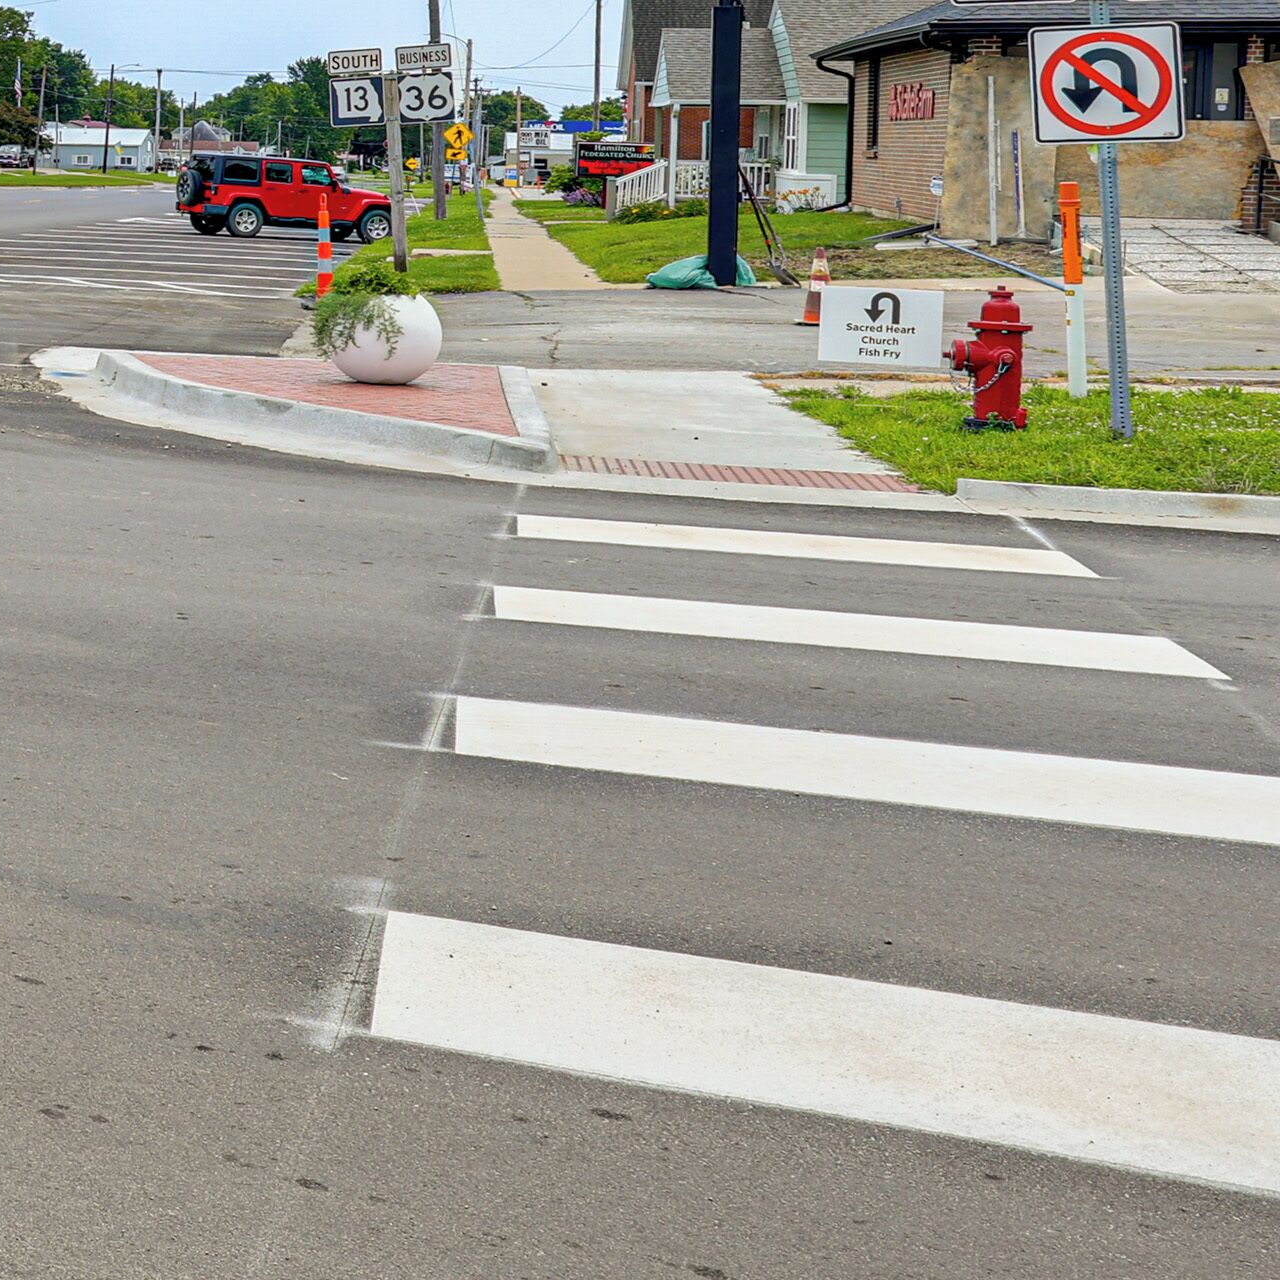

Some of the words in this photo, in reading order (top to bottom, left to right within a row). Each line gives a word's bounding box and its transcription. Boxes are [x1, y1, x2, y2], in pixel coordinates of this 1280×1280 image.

[332, 54, 379, 70] SOUTH
[400, 50, 448, 65] BUSINESS
[344, 86, 368, 112] 13
[405, 84, 448, 111] 36
[534, 131, 549, 139] MFA
[536, 138, 546, 146] OIL
[594, 144, 636, 152] Hamilton
[846, 322, 883, 333] Sacred
[886, 324, 916, 335] Heart
[861, 335, 899, 346] Church
[858, 347, 880, 358] Fish
[883, 349, 902, 360] Fry
